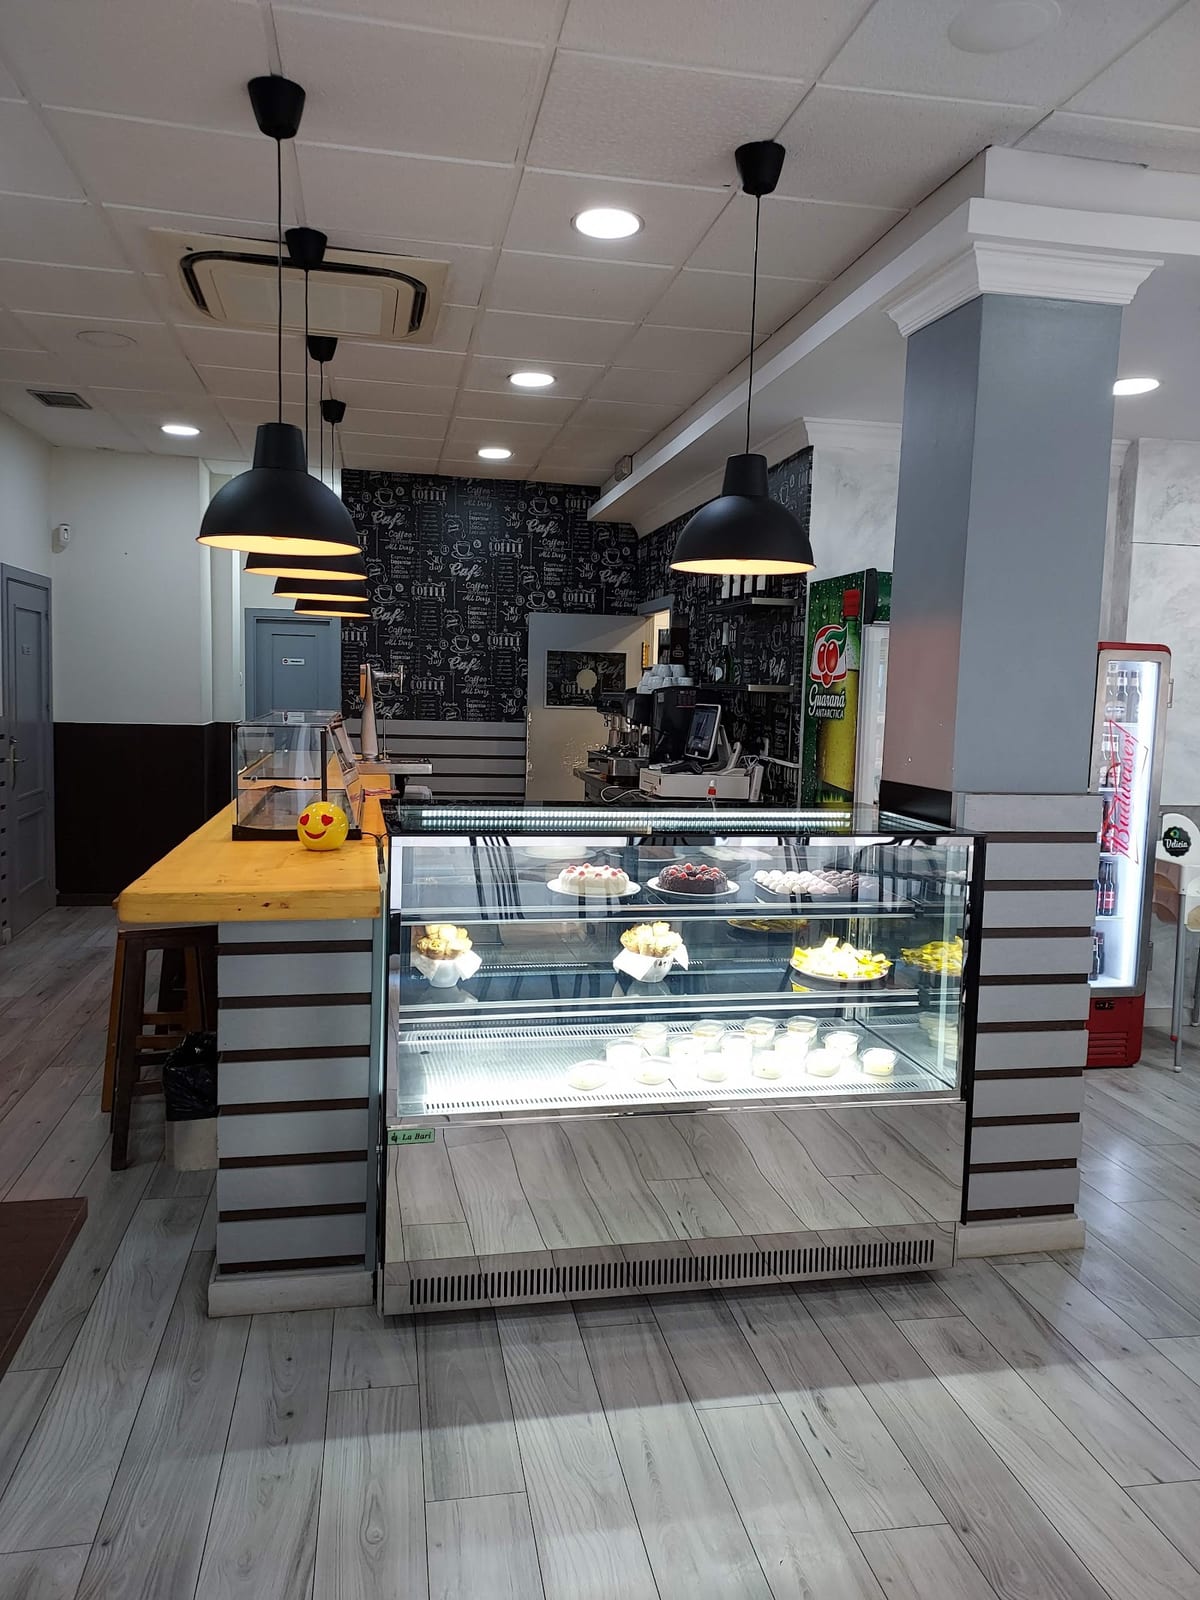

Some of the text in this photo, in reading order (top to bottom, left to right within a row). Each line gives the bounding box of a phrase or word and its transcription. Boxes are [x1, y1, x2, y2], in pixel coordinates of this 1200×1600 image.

[371, 510, 405, 529] Café
[526, 519, 558, 537] Café
[388, 531, 412, 540] Coffee
[449, 562, 482, 581] Café
[599, 569, 630, 587] Café
[466, 582, 489, 591] Coffee
[371, 607, 404, 625] Café
[388, 626, 412, 635] Coffee
[448, 656, 480, 674] Café
[464, 675, 487, 684] Coffee
[808, 684, 845, 715] Guaraná
[814, 708, 844, 718] ANTARCTICA
[1104, 733, 1139, 859] Budweiser
